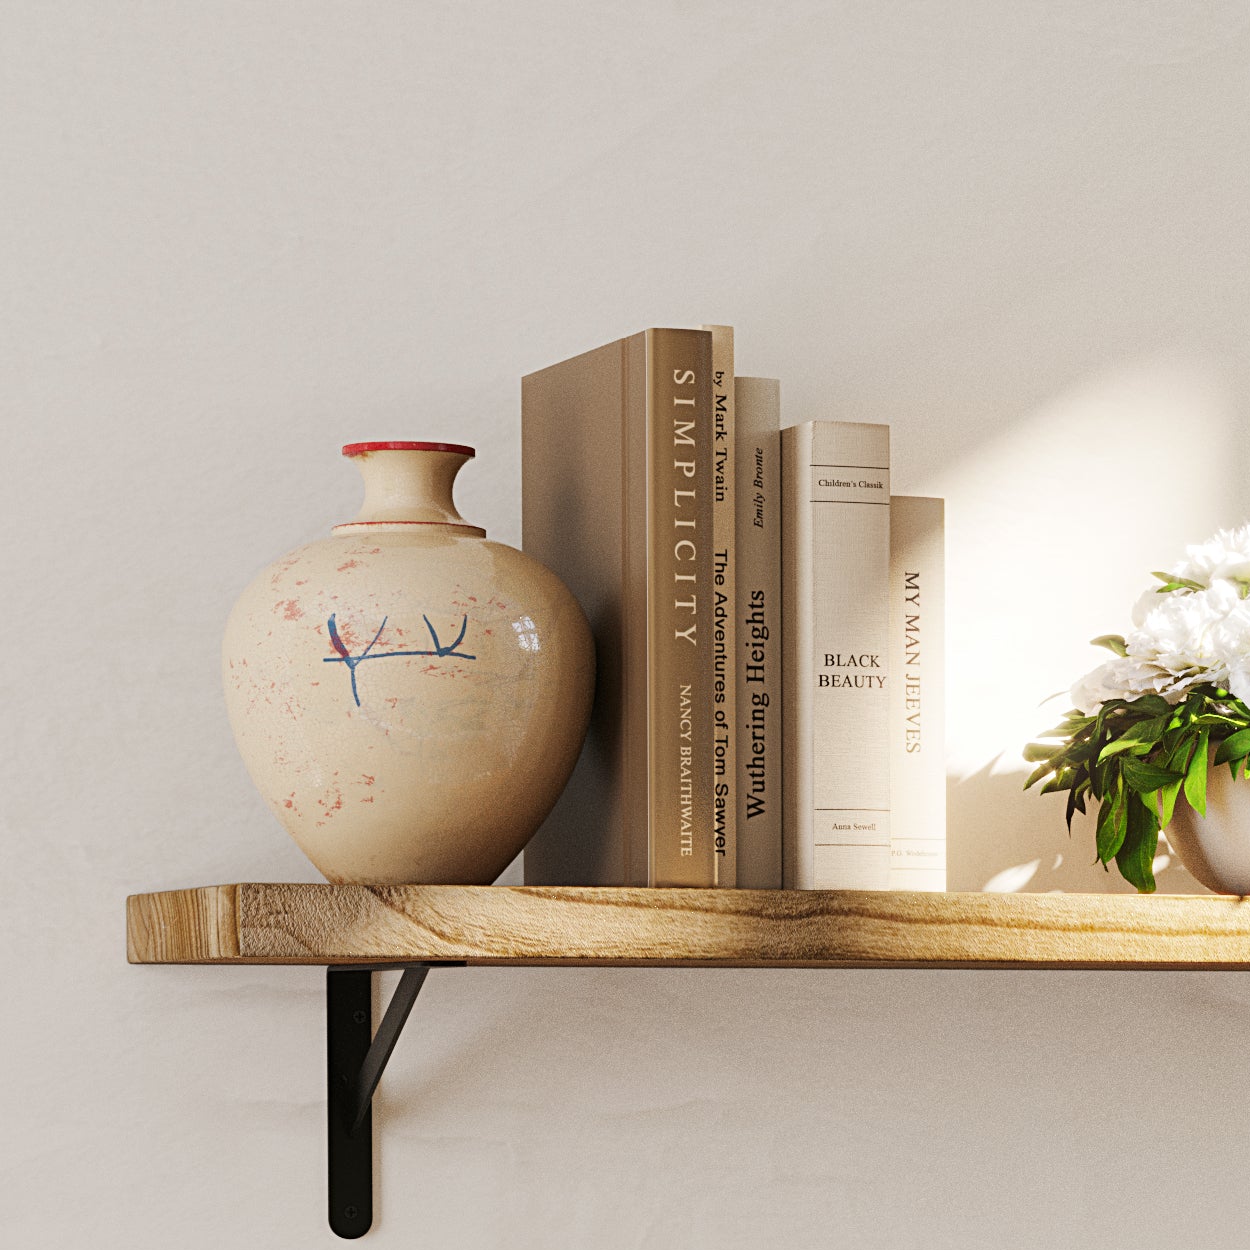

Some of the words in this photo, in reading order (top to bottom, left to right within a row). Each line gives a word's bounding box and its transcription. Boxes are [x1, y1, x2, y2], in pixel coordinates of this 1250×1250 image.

[713, 371, 725, 388] by
[715, 394, 728, 442] Mark
[715, 447, 728, 503] Twain
[753, 447, 764, 489] Bronte
[818, 479, 857, 488] Children's
[858, 480, 884, 489] Classik
[673, 369, 697, 646] SIMPLICITY
[752, 492, 766, 529] Emily
[714, 548, 728, 586] The
[904, 571, 920, 607] MY
[714, 591, 728, 704] Adventures
[745, 590, 770, 684] Heights
[905, 614, 920, 666] MAN
[818, 674, 887, 689] BEAUTY
[824, 653, 881, 668] BLACK
[679, 684, 693, 741] NANCY
[714, 710, 729, 730] of
[905, 673, 921, 754] JEEVES
[714, 735, 729, 776] Tom
[745, 692, 770, 820] Wuthering
[680, 746, 693, 857] BRAITHWAITE
[713, 783, 729, 857] Sawyer
[832, 823, 852, 831] Anna
[853, 823, 876, 831] Sewell
